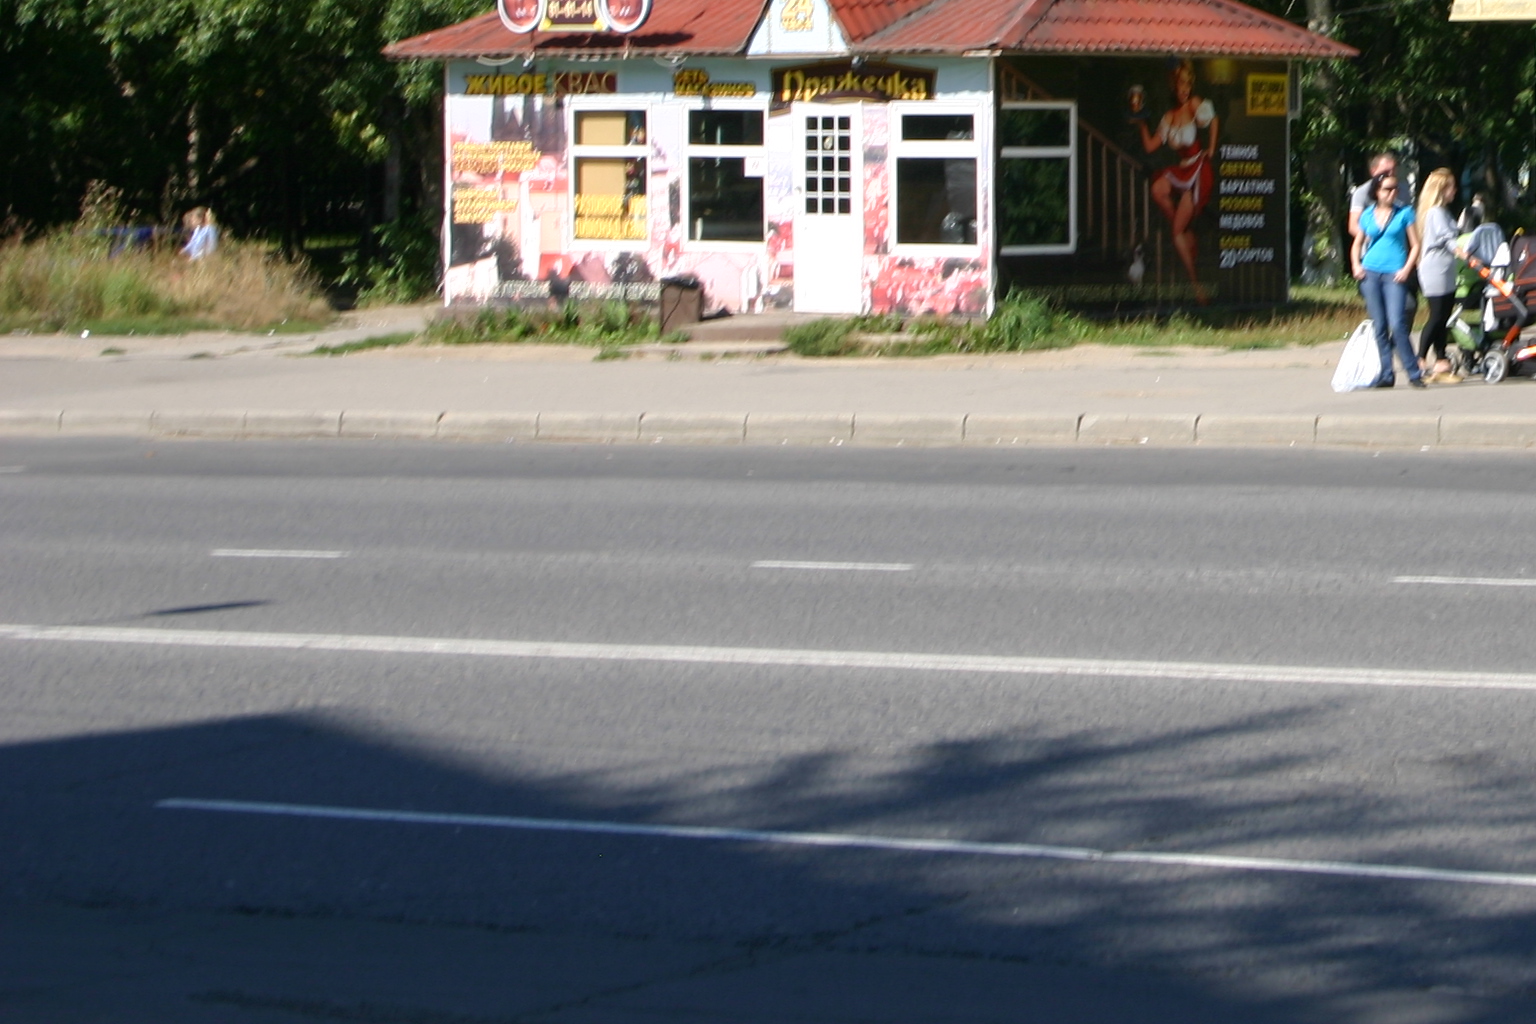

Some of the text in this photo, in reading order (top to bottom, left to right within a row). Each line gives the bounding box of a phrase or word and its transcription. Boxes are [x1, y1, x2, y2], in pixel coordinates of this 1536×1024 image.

[465, 71, 616, 95] ЖИВОЕ КВАС
[782, 70, 927, 102] Пражечка
